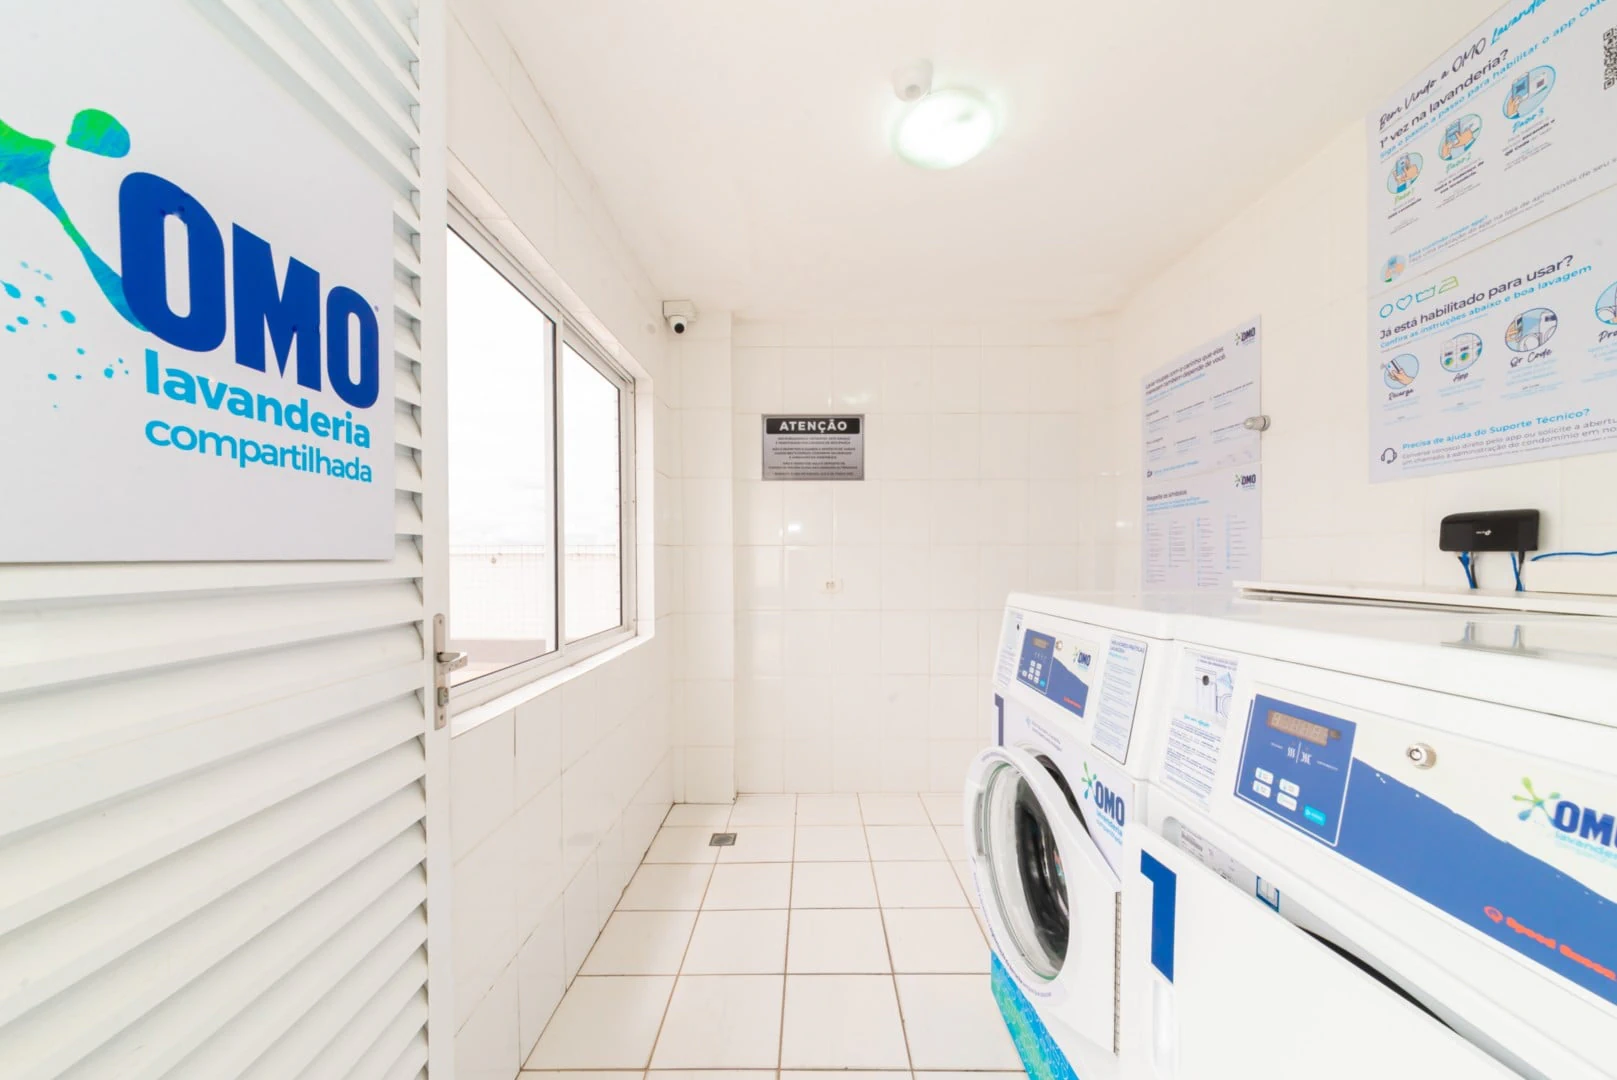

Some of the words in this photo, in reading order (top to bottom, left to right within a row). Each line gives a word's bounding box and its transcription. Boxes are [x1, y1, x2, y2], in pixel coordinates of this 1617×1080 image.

[1390, 123, 1410, 141] vez
[1411, 111, 1427, 127] na
[1429, 48, 1509, 113] lavanderia?
[1405, 122, 1429, 142] passo
[1438, 95, 1464, 120] passo
[1467, 78, 1491, 99] para
[1493, 43, 1538, 79] habilitar
[1542, 36, 1550, 45] o
[1553, 17, 1576, 38] app
[1579, 0, 1607, 17] OM
[118, 171, 380, 410] OMO
[1380, 327, 1392, 340] Já
[1394, 317, 1418, 334] está
[1420, 293, 1485, 324] habilitado
[1488, 277, 1522, 300] para
[1526, 254, 1574, 282] usar?
[1420, 312, 1467, 333] instruções
[1468, 298, 1501, 316] abaixo
[1504, 295, 1511, 303] e
[1513, 286, 1535, 301] boa
[1538, 264, 1592, 290] lavagem
[144, 347, 370, 449] lavanderia
[779, 418, 847, 433] ATENÇÃO
[144, 419, 373, 483] compartilhada
[1402, 438, 1432, 450] Precisa
[1433, 436, 1445, 445] de
[1446, 431, 1472, 443] ajuda
[1474, 428, 1488, 437] do
[1489, 419, 1533, 434] Suporte
[1536, 407, 1590, 425] Técnico?
[1505, 433, 1523, 443] app
[1537, 424, 1572, 437] solicite
[1521, 431, 1580, 448] condomínio
[1581, 428, 1600, 438] em
[1241, 473, 1257, 486] OMO
[1077, 651, 1092, 668] OMO
[1095, 780, 1125, 827] OMO
[1553, 800, 1617, 849] OM
[1140, 848, 1177, 985] 1
